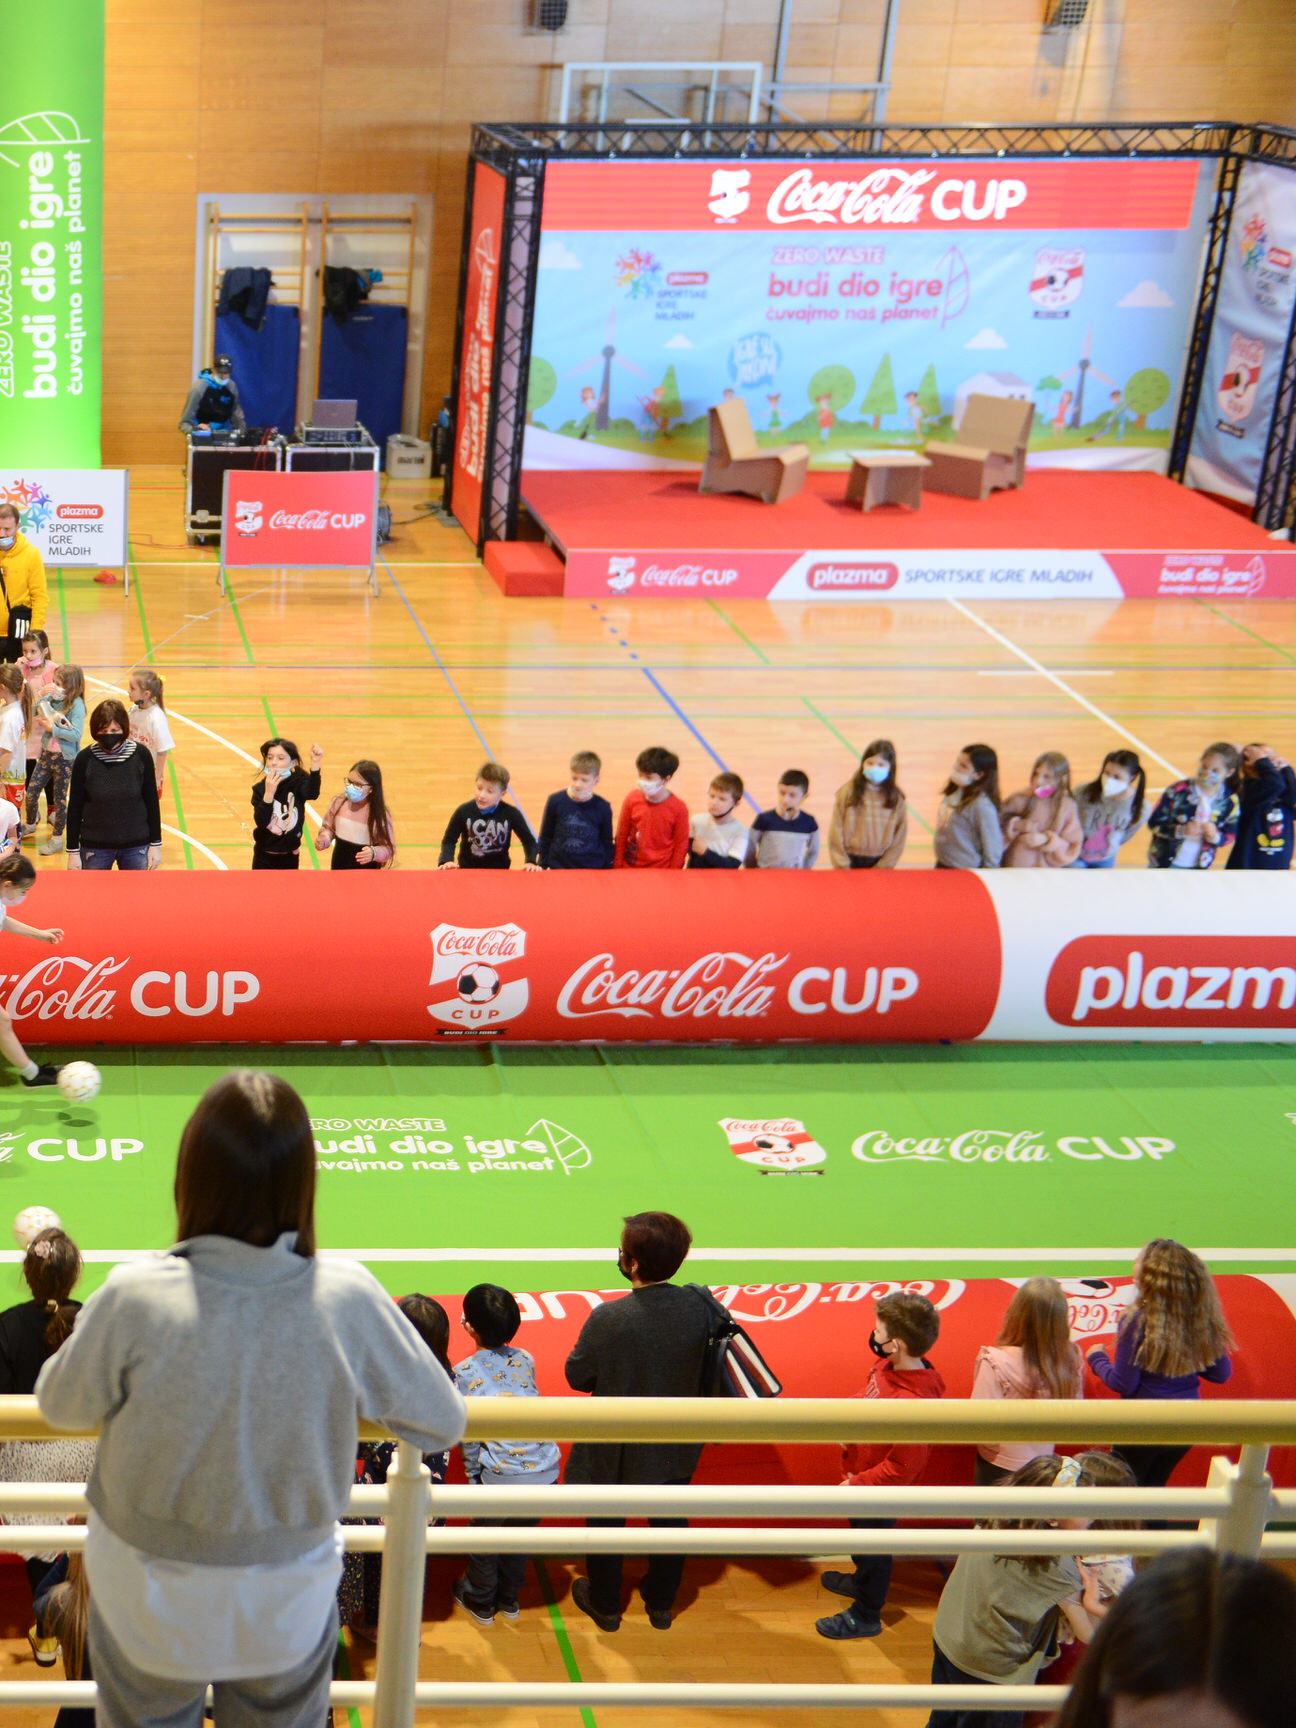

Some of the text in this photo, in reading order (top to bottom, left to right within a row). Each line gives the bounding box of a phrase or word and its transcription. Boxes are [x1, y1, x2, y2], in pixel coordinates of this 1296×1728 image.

[767, 168, 1027, 224] Coca-Cola CUP
[772, 246, 885, 265] ZERO WASTE
[19, 151, 64, 399] budi dio igre
[64, 151, 86, 395] čuvajmo naš planet
[768, 272, 943, 304] budi dio igre
[880, 305, 939, 325] planet
[60, 506, 98, 517] plazma
[269, 510, 365, 529] Coca-Cola CUP
[49, 524, 103, 533] SPORTSKE
[49, 535, 72, 544] IGRE
[49, 547, 91, 555] MLADIH
[641, 565, 737, 586] Coca-Cola CUP
[814, 566, 887, 587] plazma
[905, 569, 1092, 583] SPORTSKE IGRE MLADIH
[437, 930, 519, 956] Coca-Cola
[131, 970, 261, 1017] CUP
[557, 952, 920, 1019] Coca-Cola CUP
[1071, 951, 1296, 1021] plazm
[452, 1010, 500, 1020] CUP
[353, 1118, 447, 1132] WASTE
[726, 1120, 797, 1132] Coca-Cola
[27, 1138, 144, 1161] CUP
[316, 1135, 548, 1159] udi dio igre
[851, 1129, 1176, 1163] Coca-Cola CUP
[412, 1157, 460, 1171] naš
[468, 1157, 555, 1174] planet
[761, 1156, 806, 1164] CUP
